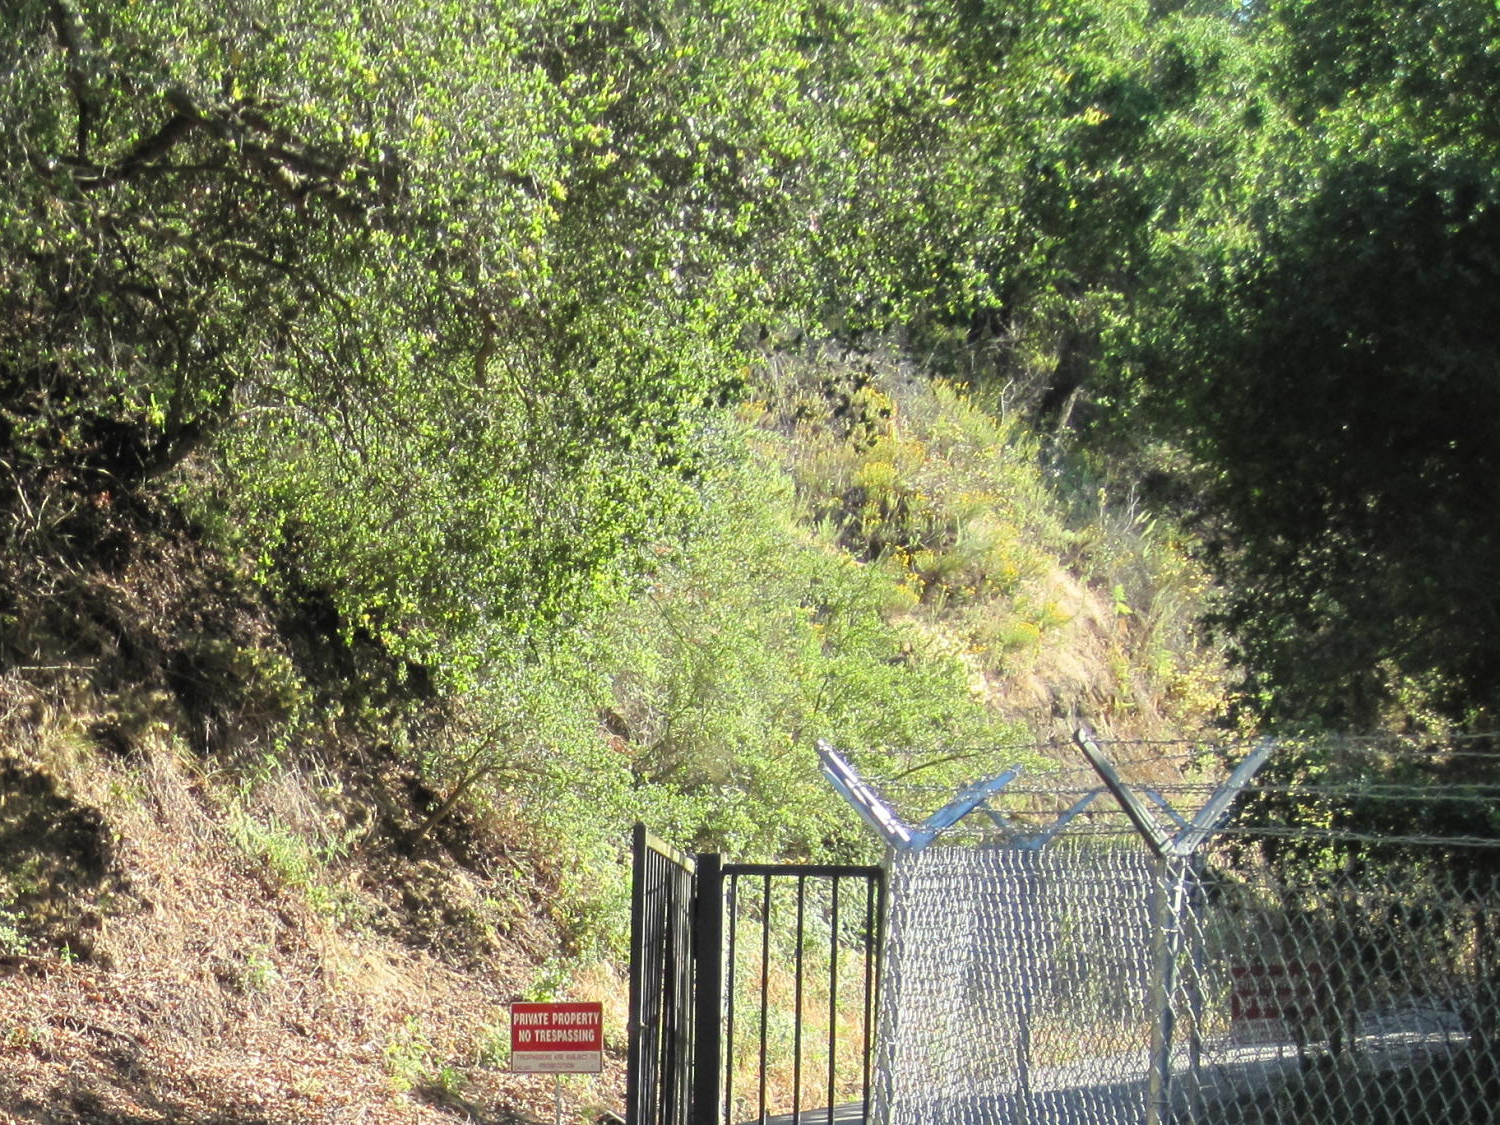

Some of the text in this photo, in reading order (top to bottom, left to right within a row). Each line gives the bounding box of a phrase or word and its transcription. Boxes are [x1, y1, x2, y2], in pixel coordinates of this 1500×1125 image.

[513, 1012, 600, 1025] PRIVATE PROPERTY
[518, 1029, 595, 1042] NO TRESPASSING
